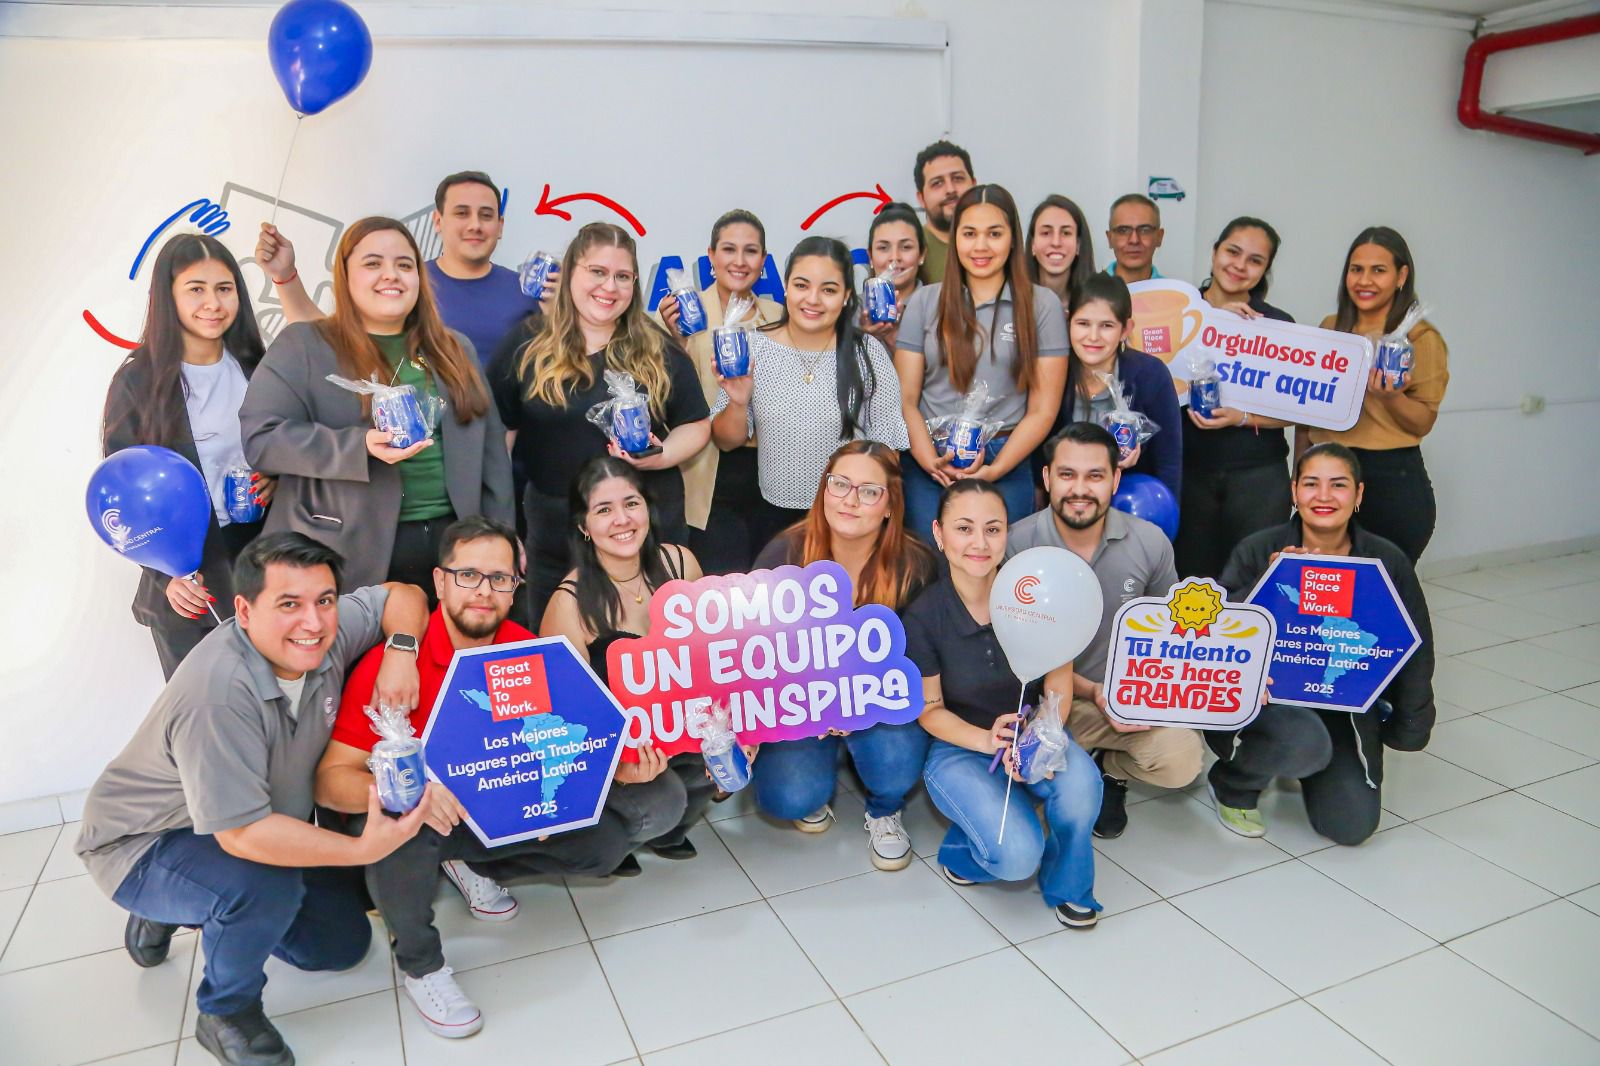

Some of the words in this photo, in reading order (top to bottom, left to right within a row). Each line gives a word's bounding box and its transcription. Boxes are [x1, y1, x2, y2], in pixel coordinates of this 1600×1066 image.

[1202, 326, 1316, 367] Orgullosos
[1321, 350, 1349, 373] de
[1276, 374, 1340, 404] aquí
[1304, 570, 1342, 582] Great
[1304, 580, 1340, 592] Place
[663, 573, 839, 639] SOMOS
[1304, 591, 1317, 600] To
[1286, 623, 1307, 635] Los
[1310, 624, 1361, 640] Mejores
[620, 645, 693, 695] UN
[708, 617, 892, 684] EQUIPO
[1160, 641, 1251, 664] talento
[1274, 639, 1302, 649] ares
[1304, 640, 1335, 653] para
[1338, 642, 1394, 659] Trabajar
[489, 661, 530, 677] Great
[1126, 659, 1174, 680] Nos
[1181, 662, 1241, 684] hace
[1273, 652, 1326, 667] América
[1328, 656, 1369, 671] Latina
[492, 675, 532, 690] Place
[1304, 682, 1335, 694] 2025
[493, 691, 510, 703] To
[730, 669, 910, 733] INSPIRA
[1116, 679, 1242, 713] GRANDES
[484, 735, 509, 750] Los
[511, 725, 568, 746] Mejores
[447, 757, 508, 778] Lugares
[511, 750, 545, 768] para
[548, 737, 608, 757] Trabajar
[478, 768, 540, 791] América
[542, 760, 587, 778] Latina
[522, 800, 558, 819] 2025
